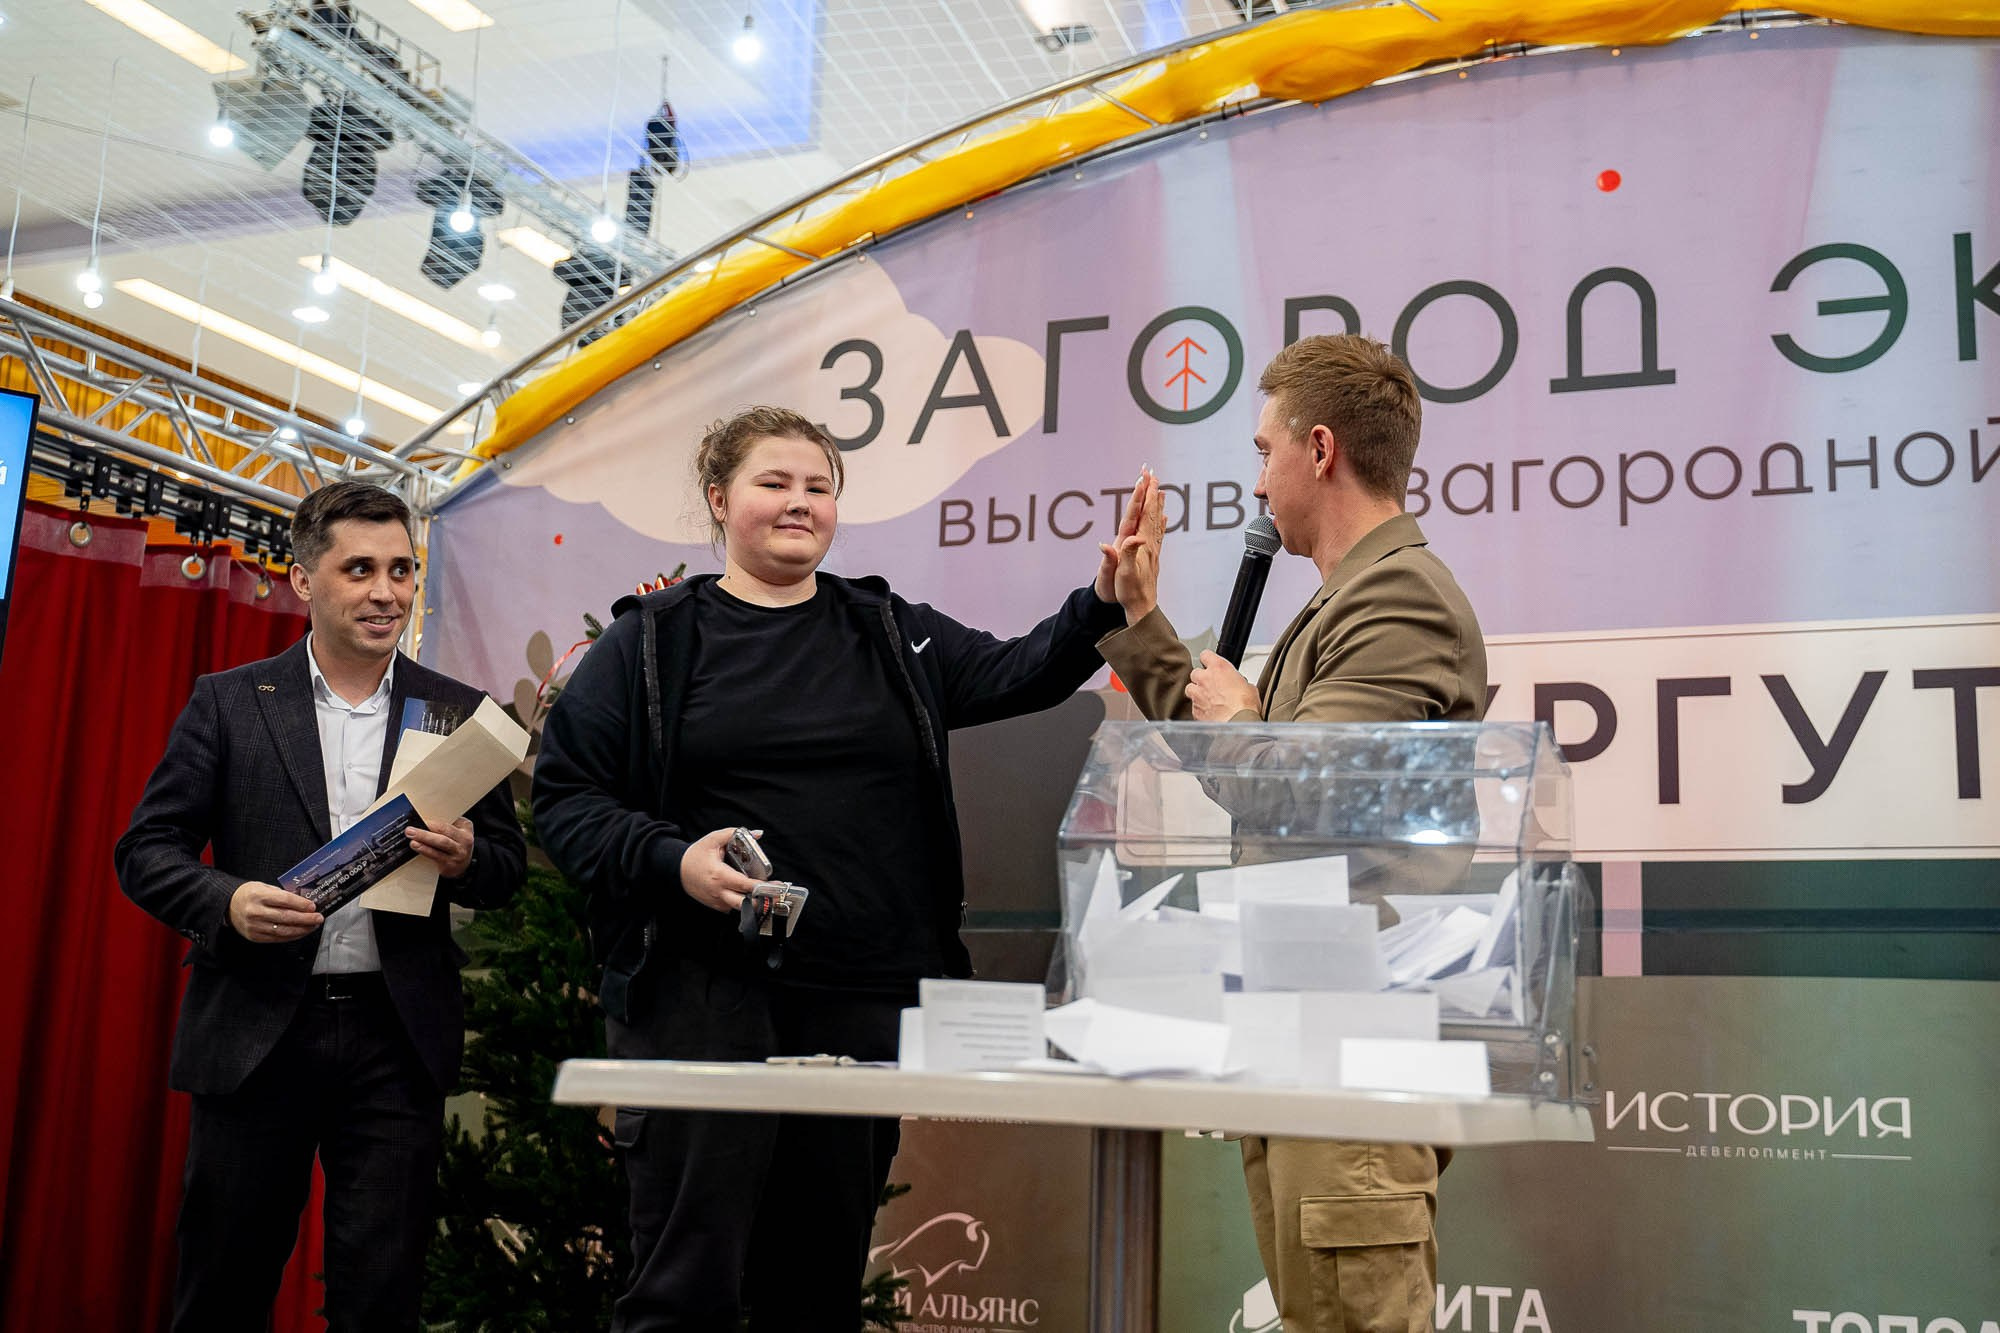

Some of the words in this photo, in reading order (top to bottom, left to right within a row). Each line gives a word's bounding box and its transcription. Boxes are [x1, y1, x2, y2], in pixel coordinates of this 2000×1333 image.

[938, 481, 1271, 547] выстав
[1482, 666, 2000, 805] РГУТ
[338, 874, 350, 885] 150
[350, 864, 363, 877] 000
[1605, 1090, 1912, 1139] ИСТОРИЯ
[1685, 1145, 1827, 1161] ДЕВЕЛОПМЕНТ
[919, 1293, 1039, 1326] АЛЬЯНС
[1435, 1283, 1553, 1333] ИТА
